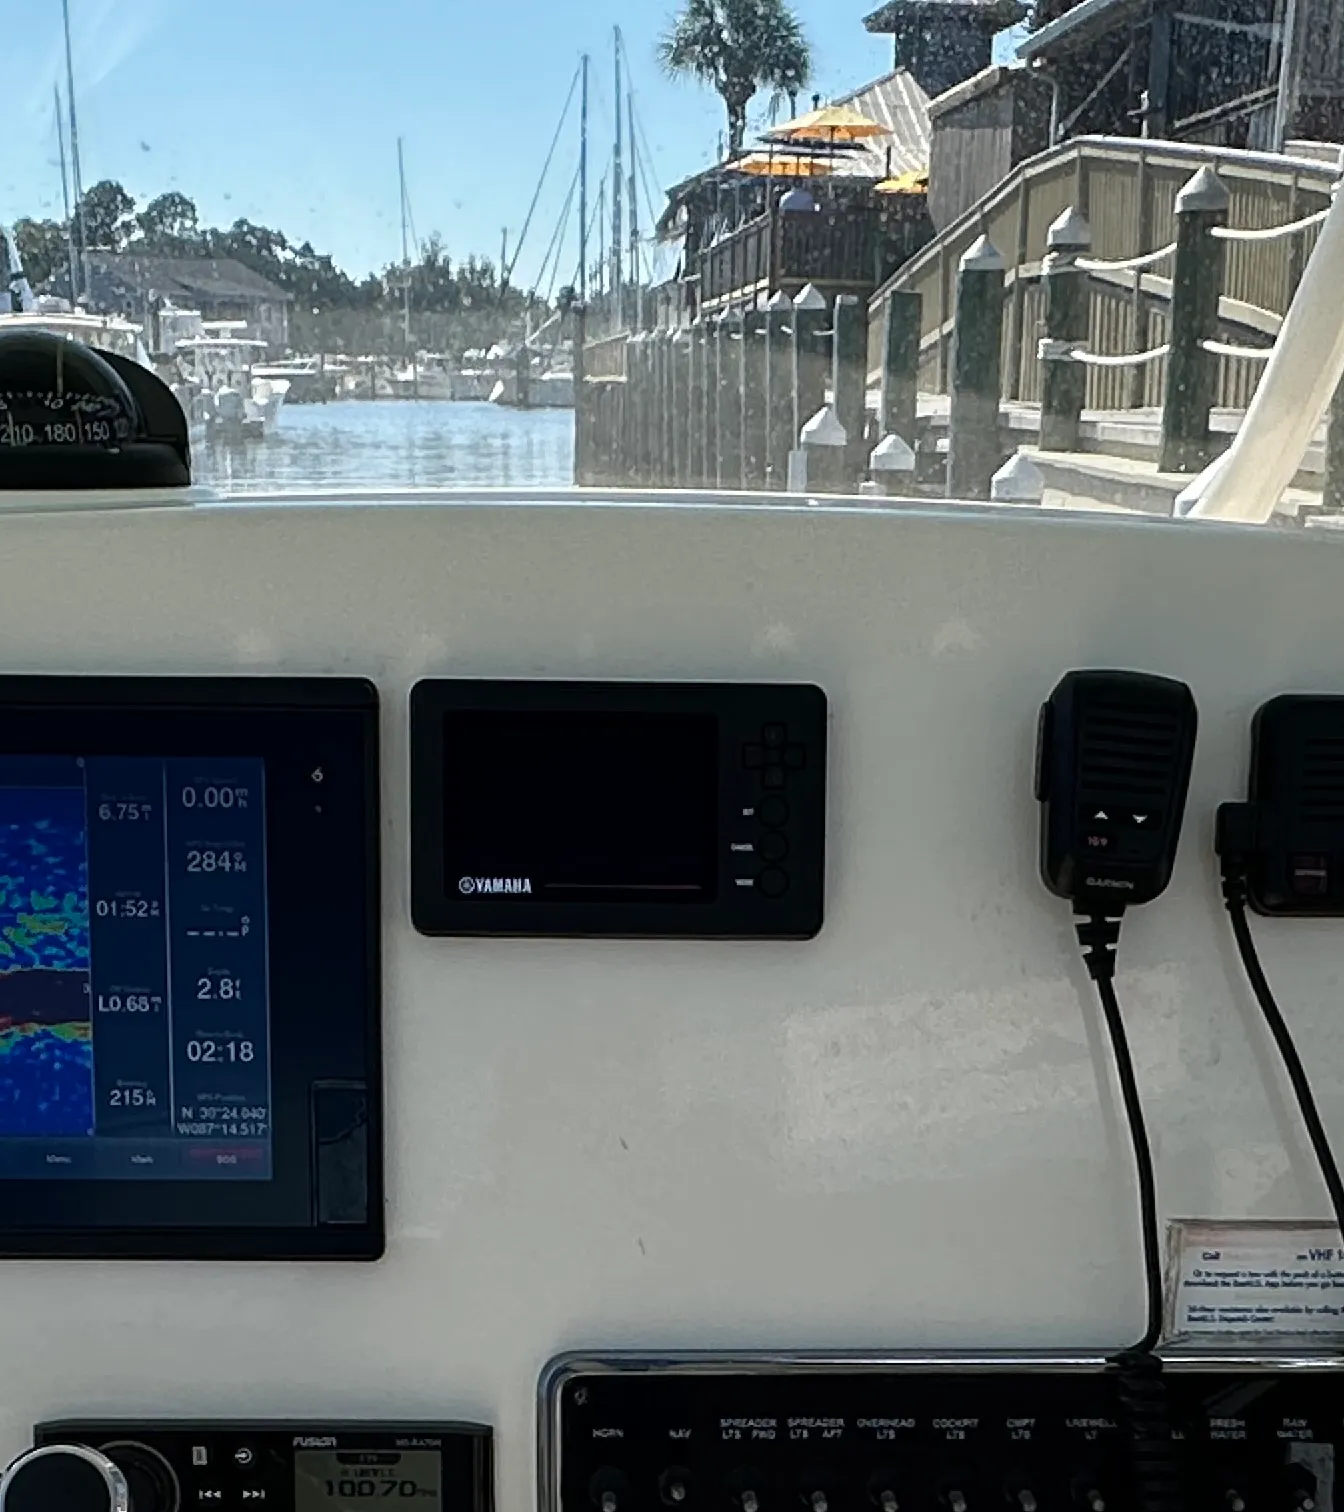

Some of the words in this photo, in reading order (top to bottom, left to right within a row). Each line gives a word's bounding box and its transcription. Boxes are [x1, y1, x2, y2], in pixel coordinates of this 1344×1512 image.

[0, 423, 34, 442] 210
[44, 424, 76, 442] 180
[85, 421, 110, 441] 150
[182, 786, 234, 808] 0.00
[98, 803, 140, 821] 6.75
[186, 850, 231, 872] 284
[474, 878, 532, 894] YAMAHA
[187, 1041, 254, 1062] 02:18
[181, 1107, 193, 1118] N
[1308, 1248, 1334, 1261] VHF
[719, 1418, 778, 1428] SPREADER
[787, 1418, 845, 1428] SPREADER
[856, 1418, 916, 1428] OVERHEAD
[932, 1418, 980, 1428] COCKPIT
[1209, 1418, 1246, 1428] FRESH
[1282, 1417, 1308, 1428] RAW
[592, 1428, 624, 1440] HORN
[668, 1428, 692, 1440] NAV
[721, 1429, 741, 1440] LTS
[789, 1429, 809, 1440] LTS
[822, 1429, 843, 1440] AFT
[876, 1429, 896, 1440] LTS
[946, 1429, 966, 1440] LTS
[1011, 1429, 1032, 1440] LTS
[1210, 1429, 1248, 1440] WATER
[1276, 1428, 1314, 1439] WATER
[291, 1436, 338, 1448] FUSION
